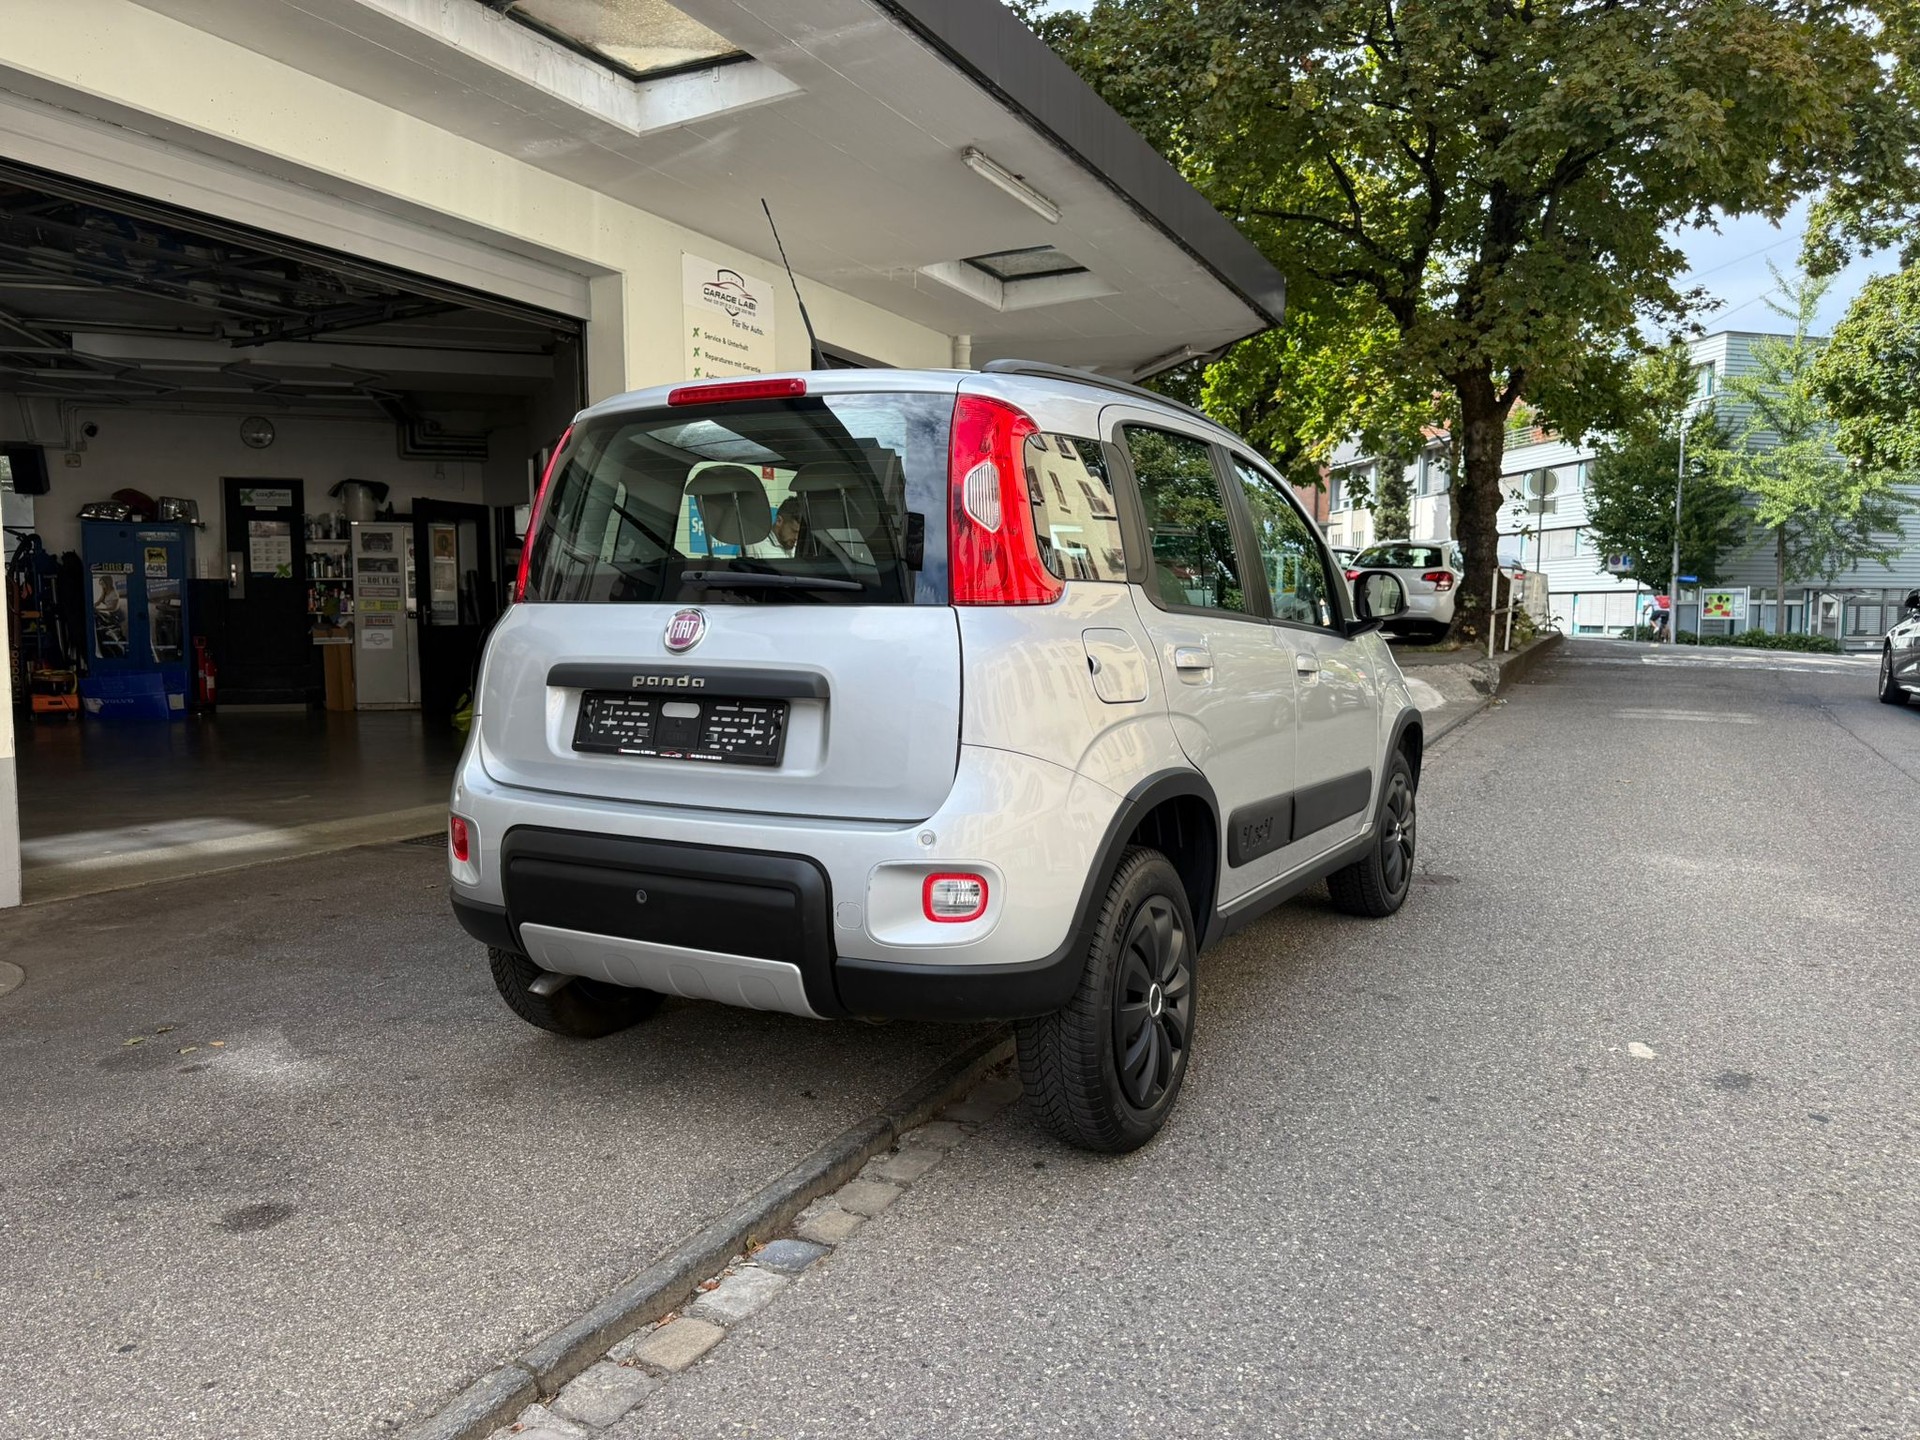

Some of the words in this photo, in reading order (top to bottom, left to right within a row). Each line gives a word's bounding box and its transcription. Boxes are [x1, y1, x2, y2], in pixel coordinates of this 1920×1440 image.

[703, 287, 737, 304] GARAGE
[704, 332, 721, 343] Service
[727, 339, 749, 351] Unterhalt
[705, 352, 733, 365] Reparaturen
[743, 362, 761, 373] Garantie
[147, 564, 166, 572] Agip
[671, 620, 697, 638] FIAT
[632, 675, 705, 688] panda
